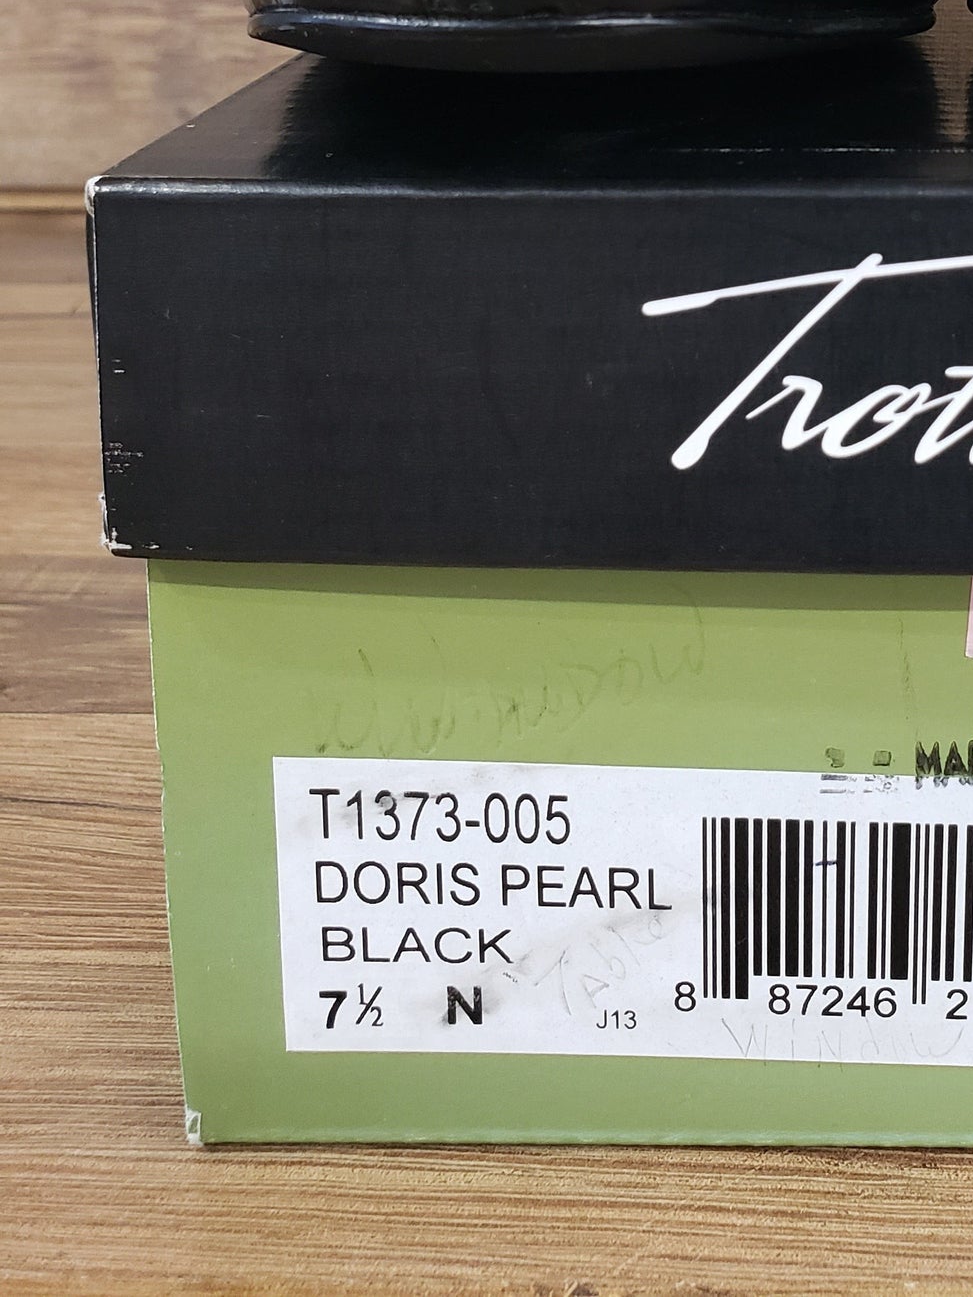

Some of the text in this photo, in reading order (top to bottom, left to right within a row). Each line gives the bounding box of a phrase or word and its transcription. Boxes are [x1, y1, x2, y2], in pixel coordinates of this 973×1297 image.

[308, 788, 572, 845] T1373-005
[315, 860, 673, 911] DORIS PEARL
[321, 926, 515, 964] BLACK
[446, 985, 483, 1025] N
[674, 981, 697, 1013] 8
[767, 983, 898, 1018] 87246
[596, 1009, 638, 1030] J13
